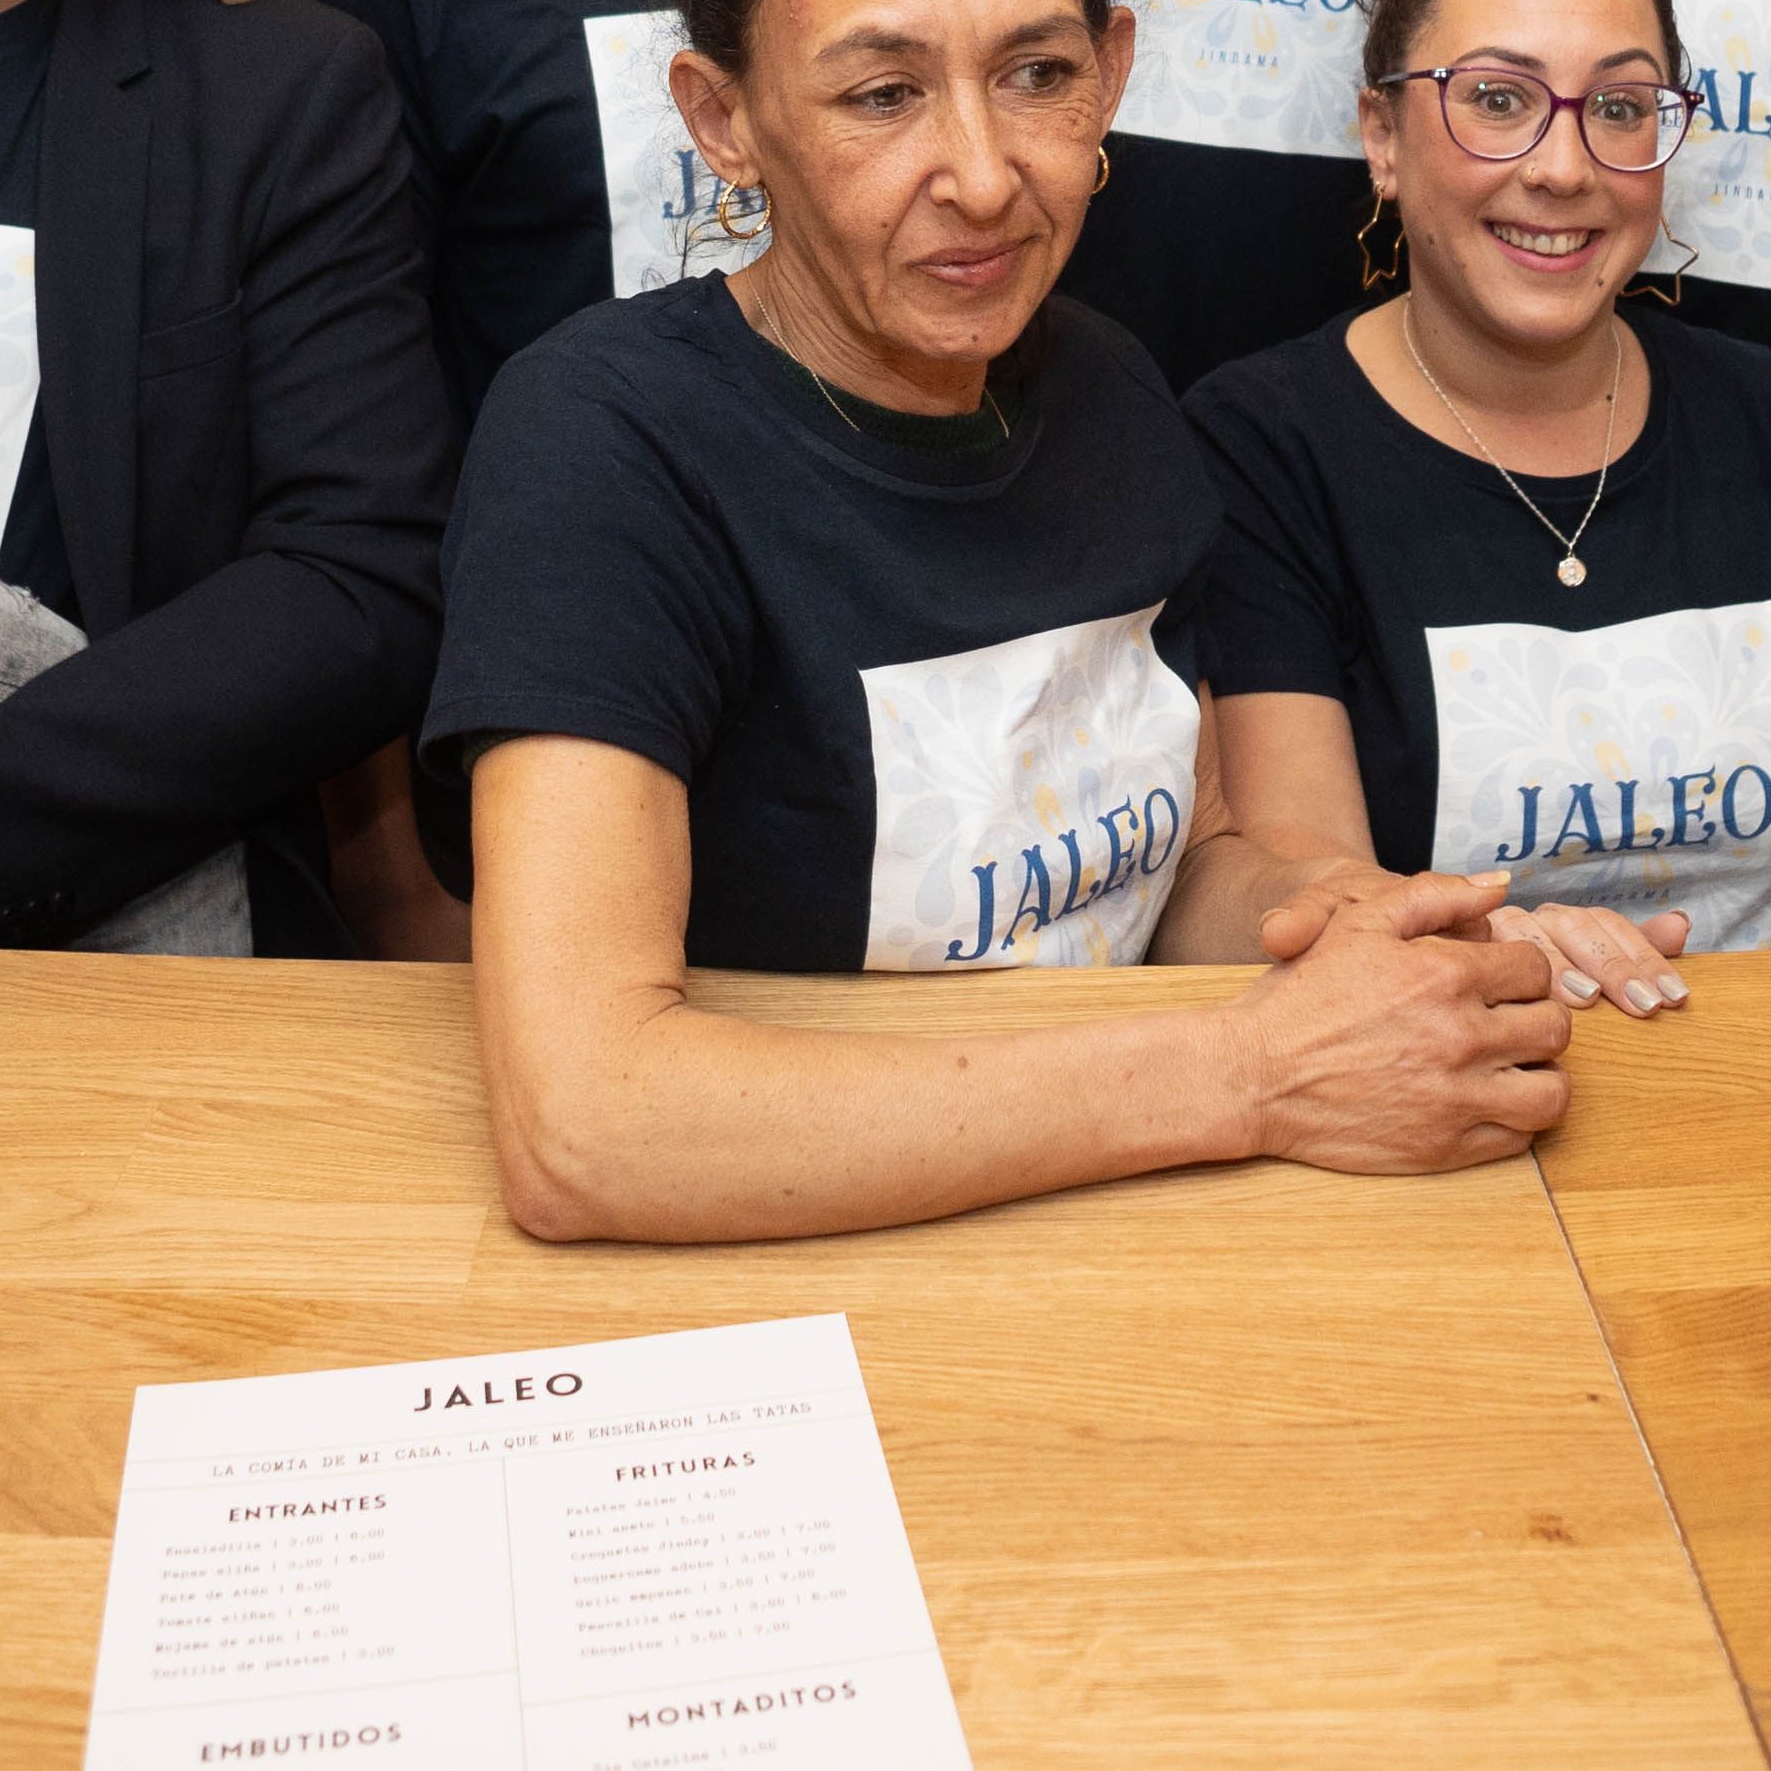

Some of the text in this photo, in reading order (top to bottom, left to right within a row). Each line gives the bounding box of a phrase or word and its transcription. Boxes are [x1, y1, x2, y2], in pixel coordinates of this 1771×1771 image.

[1197, 47, 1282, 70] JINDAMA
[945, 785, 1182, 964] JALEO
[413, 1372, 583, 1413] JALEO
[212, 1463, 235, 1479] LA
[248, 1455, 309, 1476] COMÍA
[321, 1455, 347, 1469] DE
[358, 1450, 382, 1465] MI
[467, 1439, 491, 1454] LA
[503, 1434, 540, 1451] QUE
[551, 1429, 576, 1444] ME
[587, 1416, 695, 1442] ENSEÑARON
[706, 1410, 743, 1426] LAS
[752, 1402, 814, 1419] TATAS
[614, 1450, 758, 1483] FRITURAS
[228, 1493, 389, 1524] ENTRANTES
[628, 1679, 860, 1731] MONTADITOS
[198, 1722, 405, 1765] EMBUTIDOS
